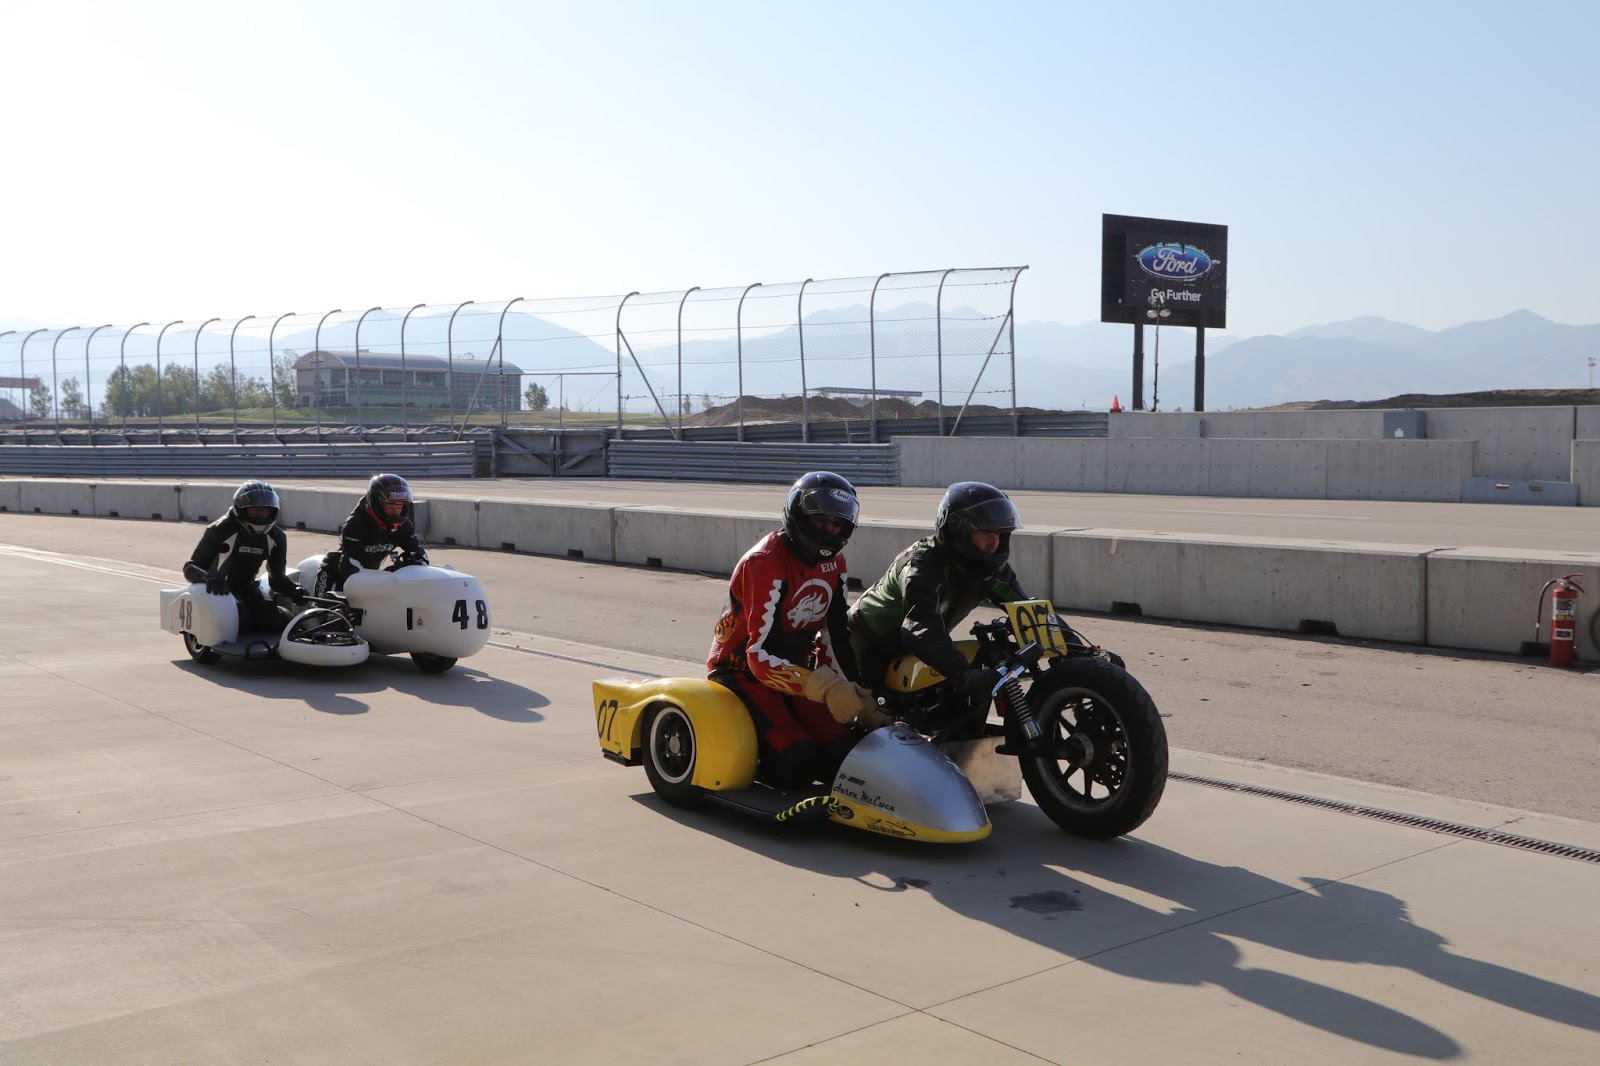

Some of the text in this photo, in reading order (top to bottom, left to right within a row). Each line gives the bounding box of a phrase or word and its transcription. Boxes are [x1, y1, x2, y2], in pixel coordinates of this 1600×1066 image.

[1152, 247, 1198, 275] Ford
[1150, 288, 1202, 302] Go Further
[179, 598, 192, 630] 48
[452, 599, 488, 630] 48
[597, 699, 619, 742] 07
[832, 783, 858, 799] Aaron
[861, 790, 896, 812] McEwen
